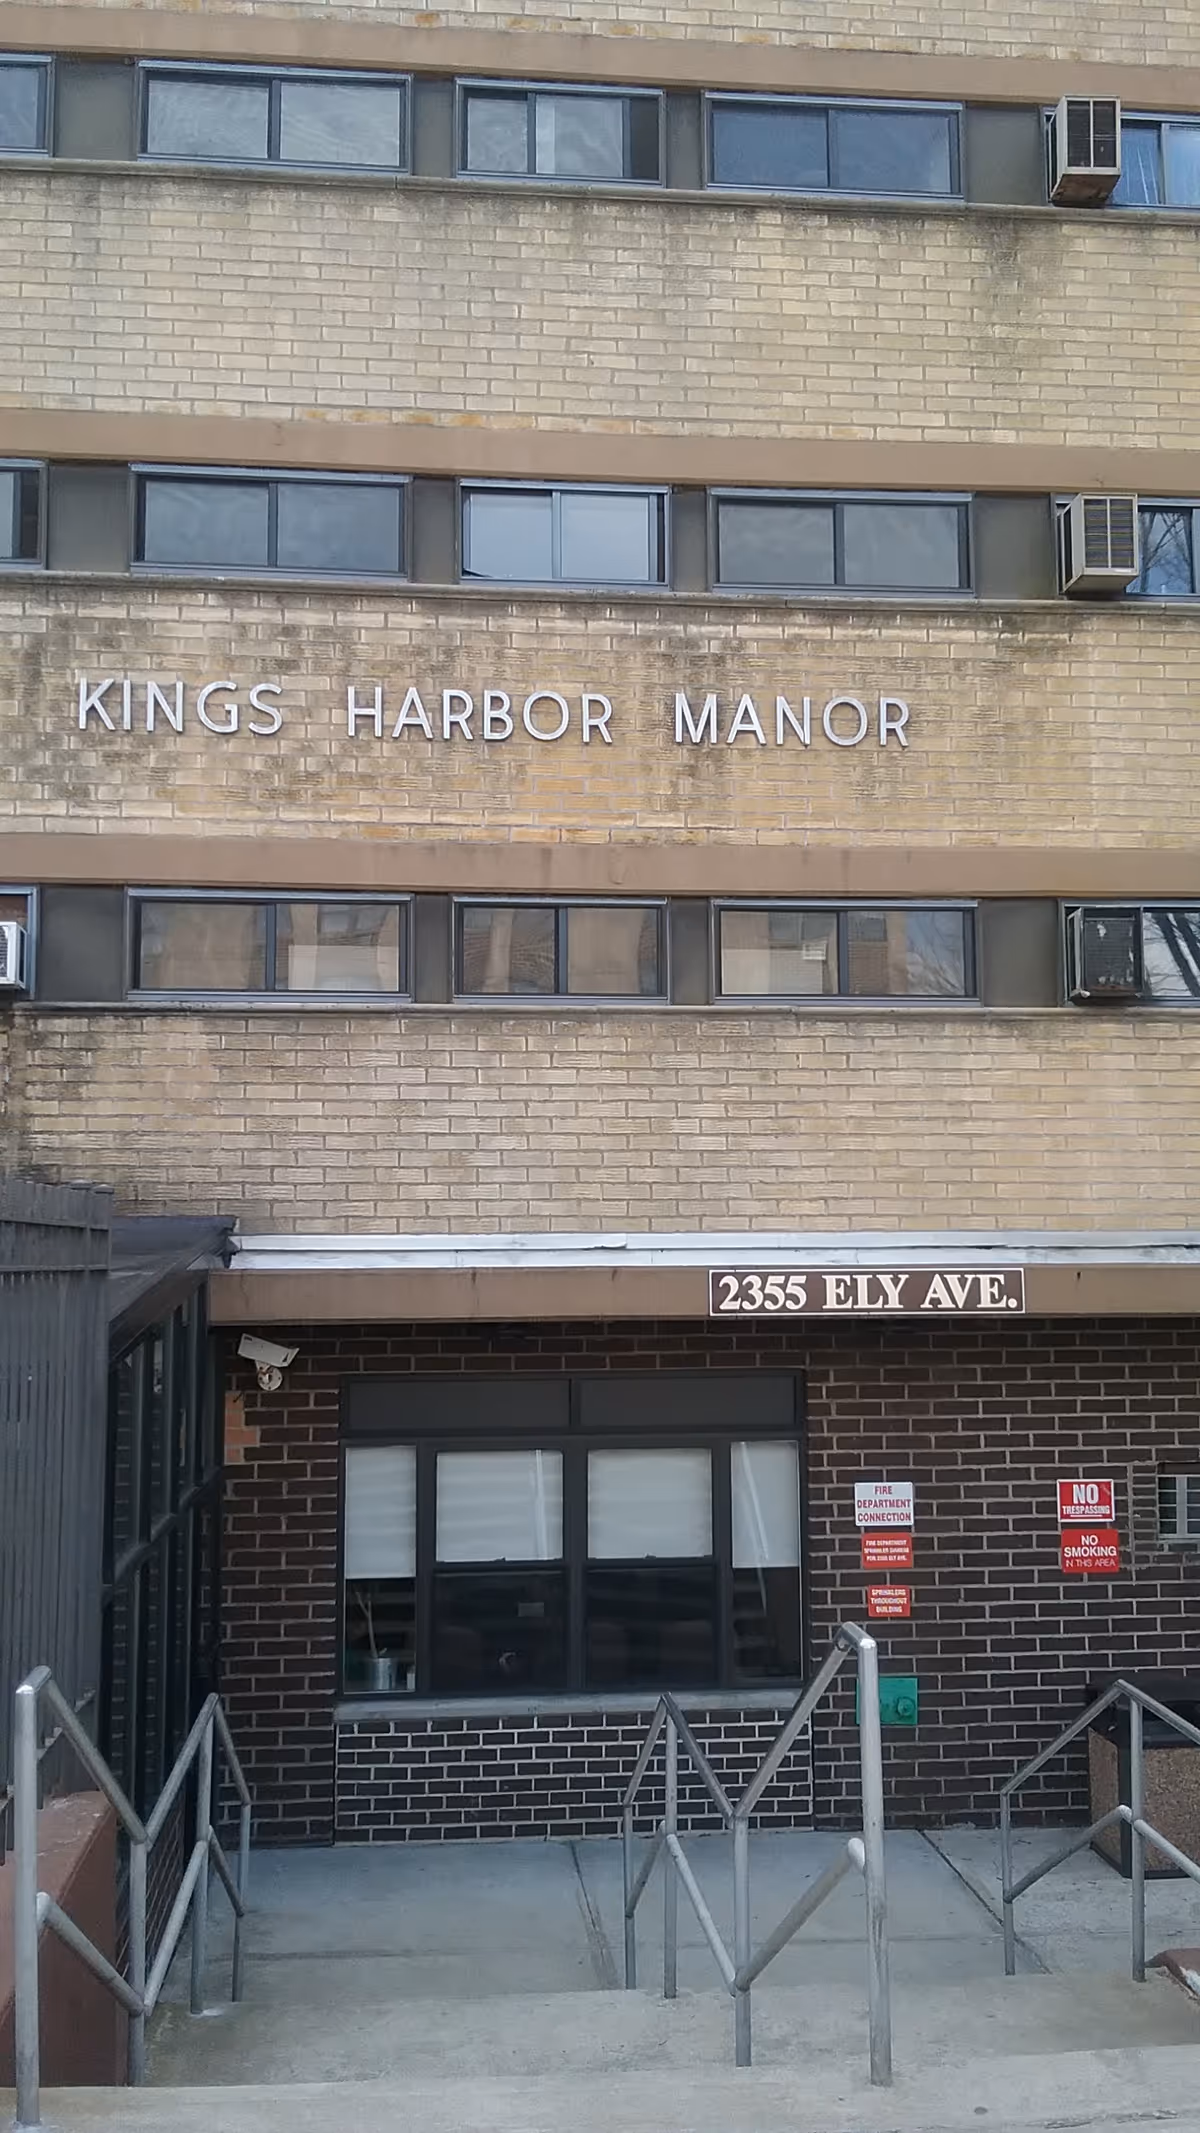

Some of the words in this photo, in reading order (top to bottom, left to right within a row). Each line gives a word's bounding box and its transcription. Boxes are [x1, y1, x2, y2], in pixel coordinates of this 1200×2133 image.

[77, 677, 284, 736] KINGS
[346, 685, 613, 744] HARBOR
[674, 692, 910, 748] MANOR
[718, 1274, 808, 1311] 2355
[821, 1273, 909, 1310] ELY
[919, 1272, 1019, 1310] AVE.
[874, 1485, 892, 1495] FIRE
[1072, 1483, 1098, 1504] NO
[857, 1499, 911, 1509] DEPARTMENT
[1062, 1505, 1110, 1515] TRESPASSING
[857, 1512, 911, 1523] CONNECTION
[1081, 1534, 1098, 1545] NO
[1063, 1545, 1117, 1558] SMOKING
[1065, 1558, 1073, 1568] IN
[1075, 1558, 1092, 1568] THIS
[1094, 1557, 1116, 1567] AREA
